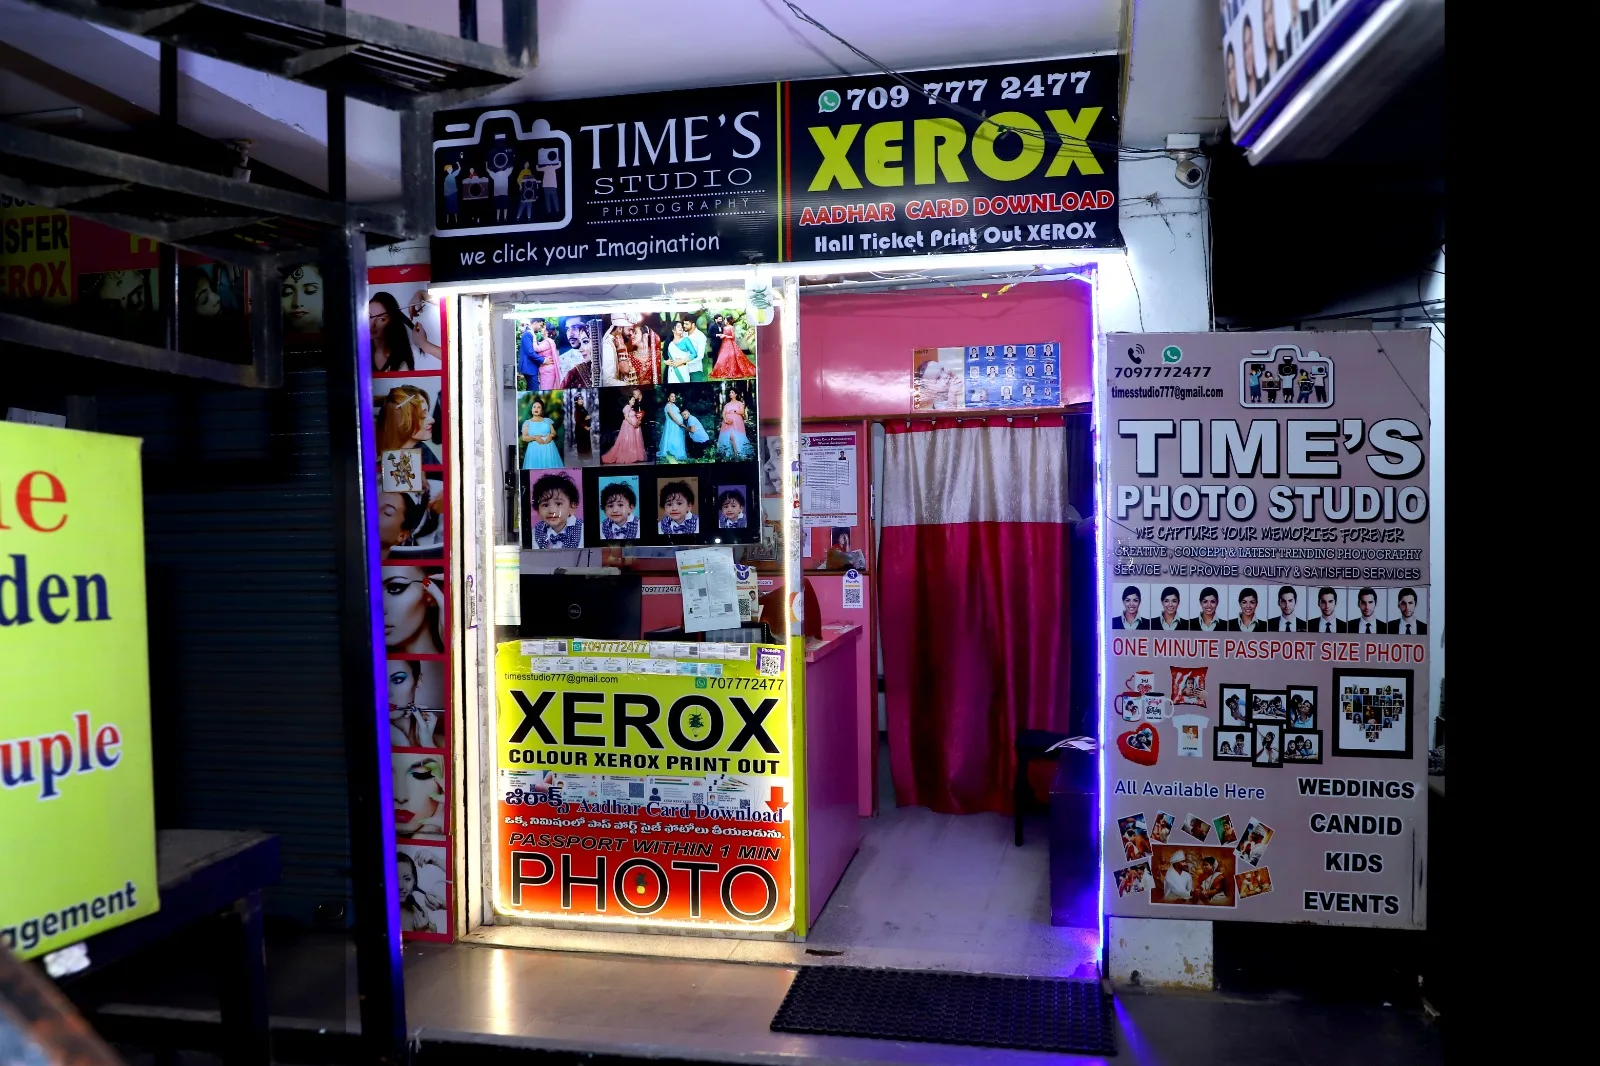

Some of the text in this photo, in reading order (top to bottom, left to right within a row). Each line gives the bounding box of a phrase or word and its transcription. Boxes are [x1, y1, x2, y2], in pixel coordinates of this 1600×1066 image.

[846, 71, 1091, 110] 709 777 2477
[580, 111, 761, 169] TIME'S
[807, 106, 1104, 192] XEROX
[595, 168, 752, 195] STUDIO
[602, 198, 750, 217] PHOTOGRAPHY
[799, 190, 1114, 226] AADHAR CARD DOWNLOAD
[0, 215, 68, 253] SFER
[815, 222, 1096, 253] Hall Ticket Print Out XEROX
[460, 232, 720, 266] we click your Imagination
[1114, 366, 1211, 378] 7097772477
[1111, 385, 1224, 400] timesstudio777@gmail.com
[1118, 418, 1425, 479] TIME'S
[1116, 485, 1429, 523] PHOTO STUDIO
[1136, 526, 1404, 543] WE CAPTURE YOUR MEMORIES FOREVER
[1114, 546, 1167, 557] CREATIVE
[1174, 546, 1227, 557] CONCEPT
[1228, 547, 1236, 557] &
[1238, 547, 1276, 558] LATEST
[1278, 548, 1335, 559] TRENDING
[1337, 549, 1422, 560] PHOTOGRAPHY
[1114, 564, 1161, 576] SERVICE
[1169, 564, 1187, 576] WE
[1243, 565, 1290, 578] QUALITY
[1293, 566, 1301, 577] &
[1363, 567, 1420, 579] SERVICES
[1113, 637, 1425, 664] ONE MINUTE PASSPORT SIZE PHOTO
[504, 672, 618, 684] timesstudio777@gmail.com
[709, 677, 784, 690] 707772477
[509, 690, 781, 754] XEROX
[509, 749, 780, 775] COLOUR XEROX PRINT OUT
[1114, 780, 1265, 800] All Available Here
[1298, 778, 1415, 799] WEDDINGS
[577, 799, 641, 815] Aadhar
[646, 801, 690, 818] Card
[696, 803, 784, 823] Download
[1309, 813, 1402, 836] CANDID
[509, 833, 781, 861] PASSPORT WITHIN 1 MIN
[1325, 852, 1383, 873] KIDS
[511, 850, 779, 922] PHOTO
[1303, 891, 1399, 915] EVENTS
